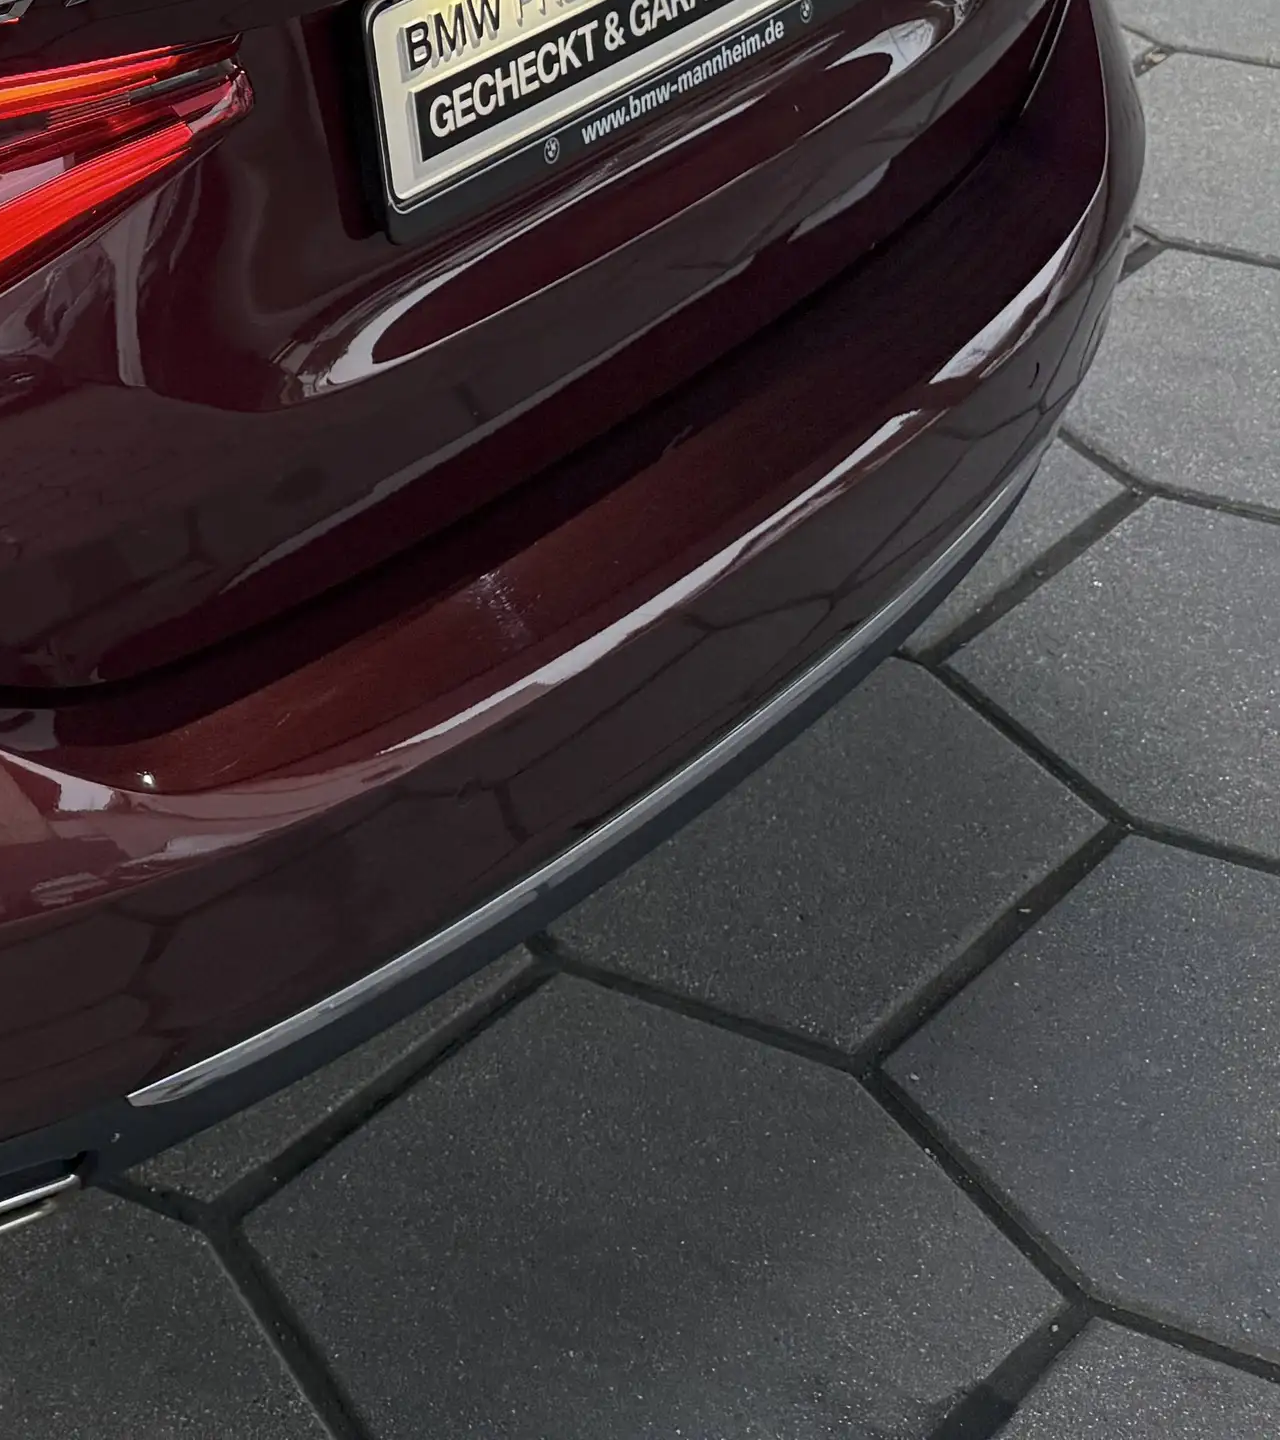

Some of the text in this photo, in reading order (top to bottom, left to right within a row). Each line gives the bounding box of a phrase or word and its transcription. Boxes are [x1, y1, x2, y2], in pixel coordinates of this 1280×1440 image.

[429, 19, 598, 137] GECHECKT
[603, 10, 626, 51] &
[581, 17, 786, 145] www.bmw-mannheim.de
